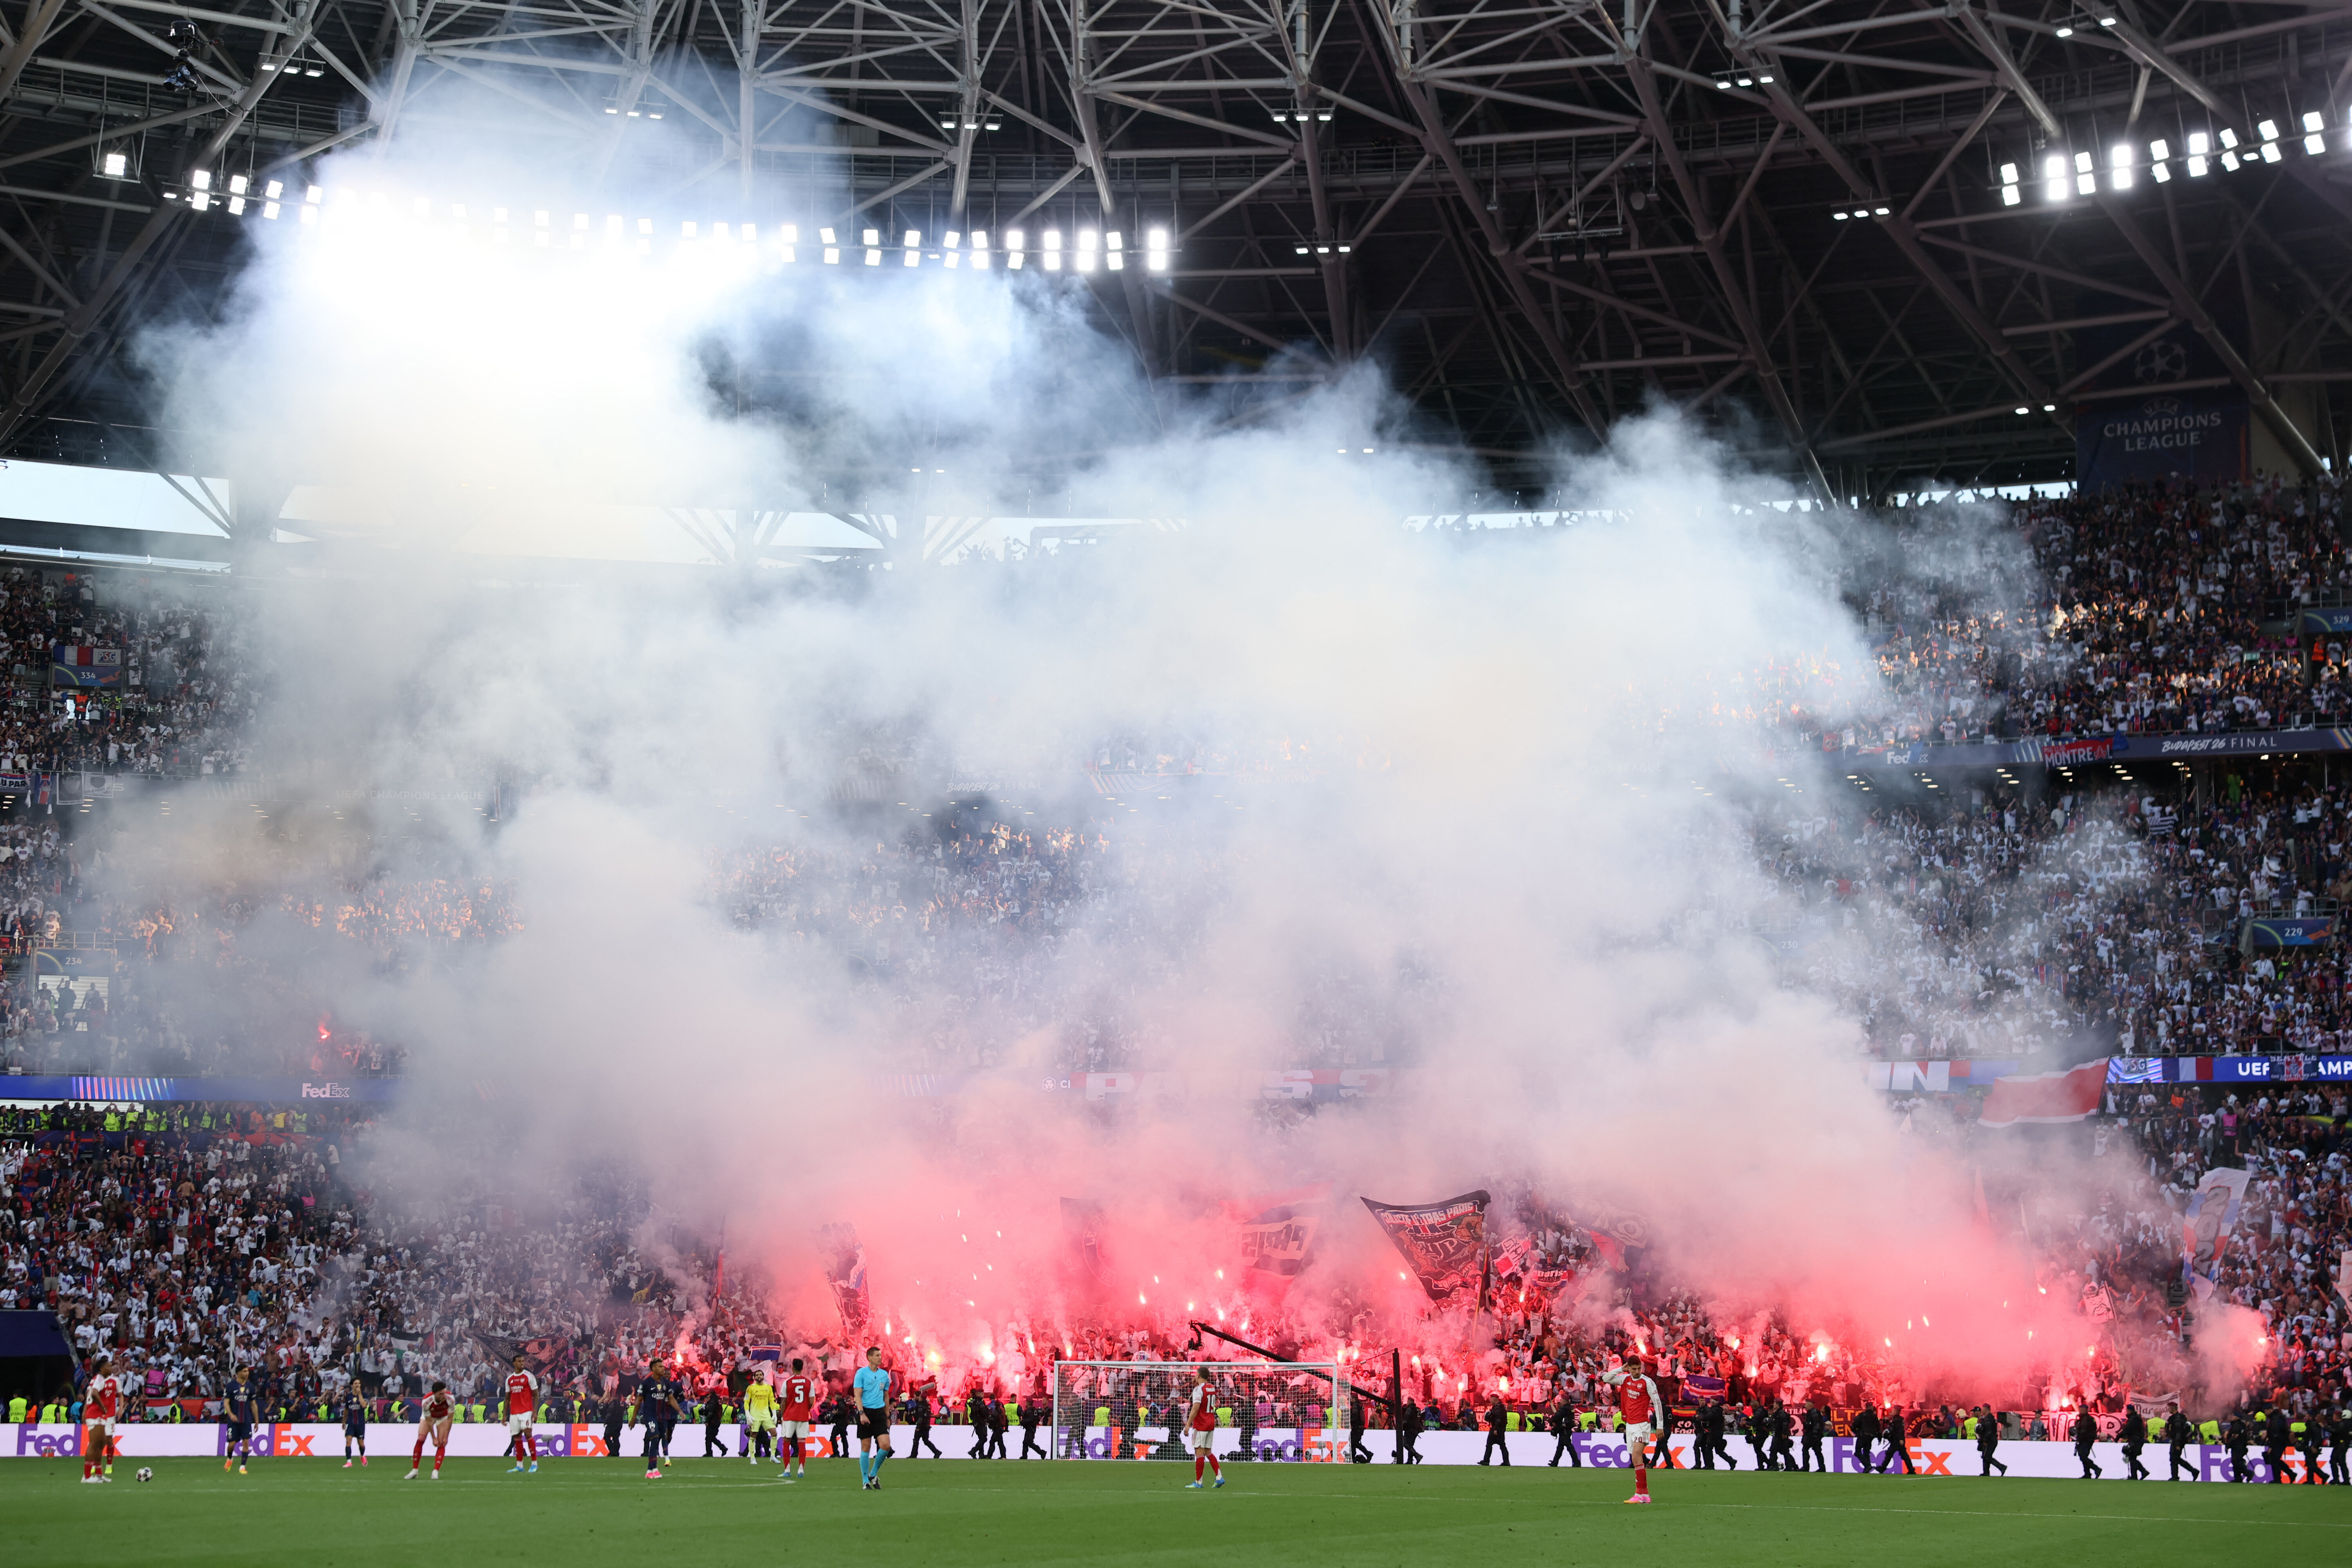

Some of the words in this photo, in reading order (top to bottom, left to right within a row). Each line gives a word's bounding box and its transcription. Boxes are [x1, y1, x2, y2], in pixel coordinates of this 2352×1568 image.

[2104, 412, 2221, 437] CHAMPIONS
[2125, 431, 2201, 452] LEAGUE
[2333, 615, 2349, 624] 329
[2231, 737, 2277, 748] FINAL
[1887, 751, 1928, 764] Fedx
[2285, 927, 2302, 937] 229
[66, 957, 82, 965] 234
[302, 1083, 350, 1098] FedEx
[1446, 1202, 1474, 1218] PARIS
[795, 1385, 804, 1403] 5
[648, 1421, 656, 1429] 14
[228, 1427, 232, 1436] 2
